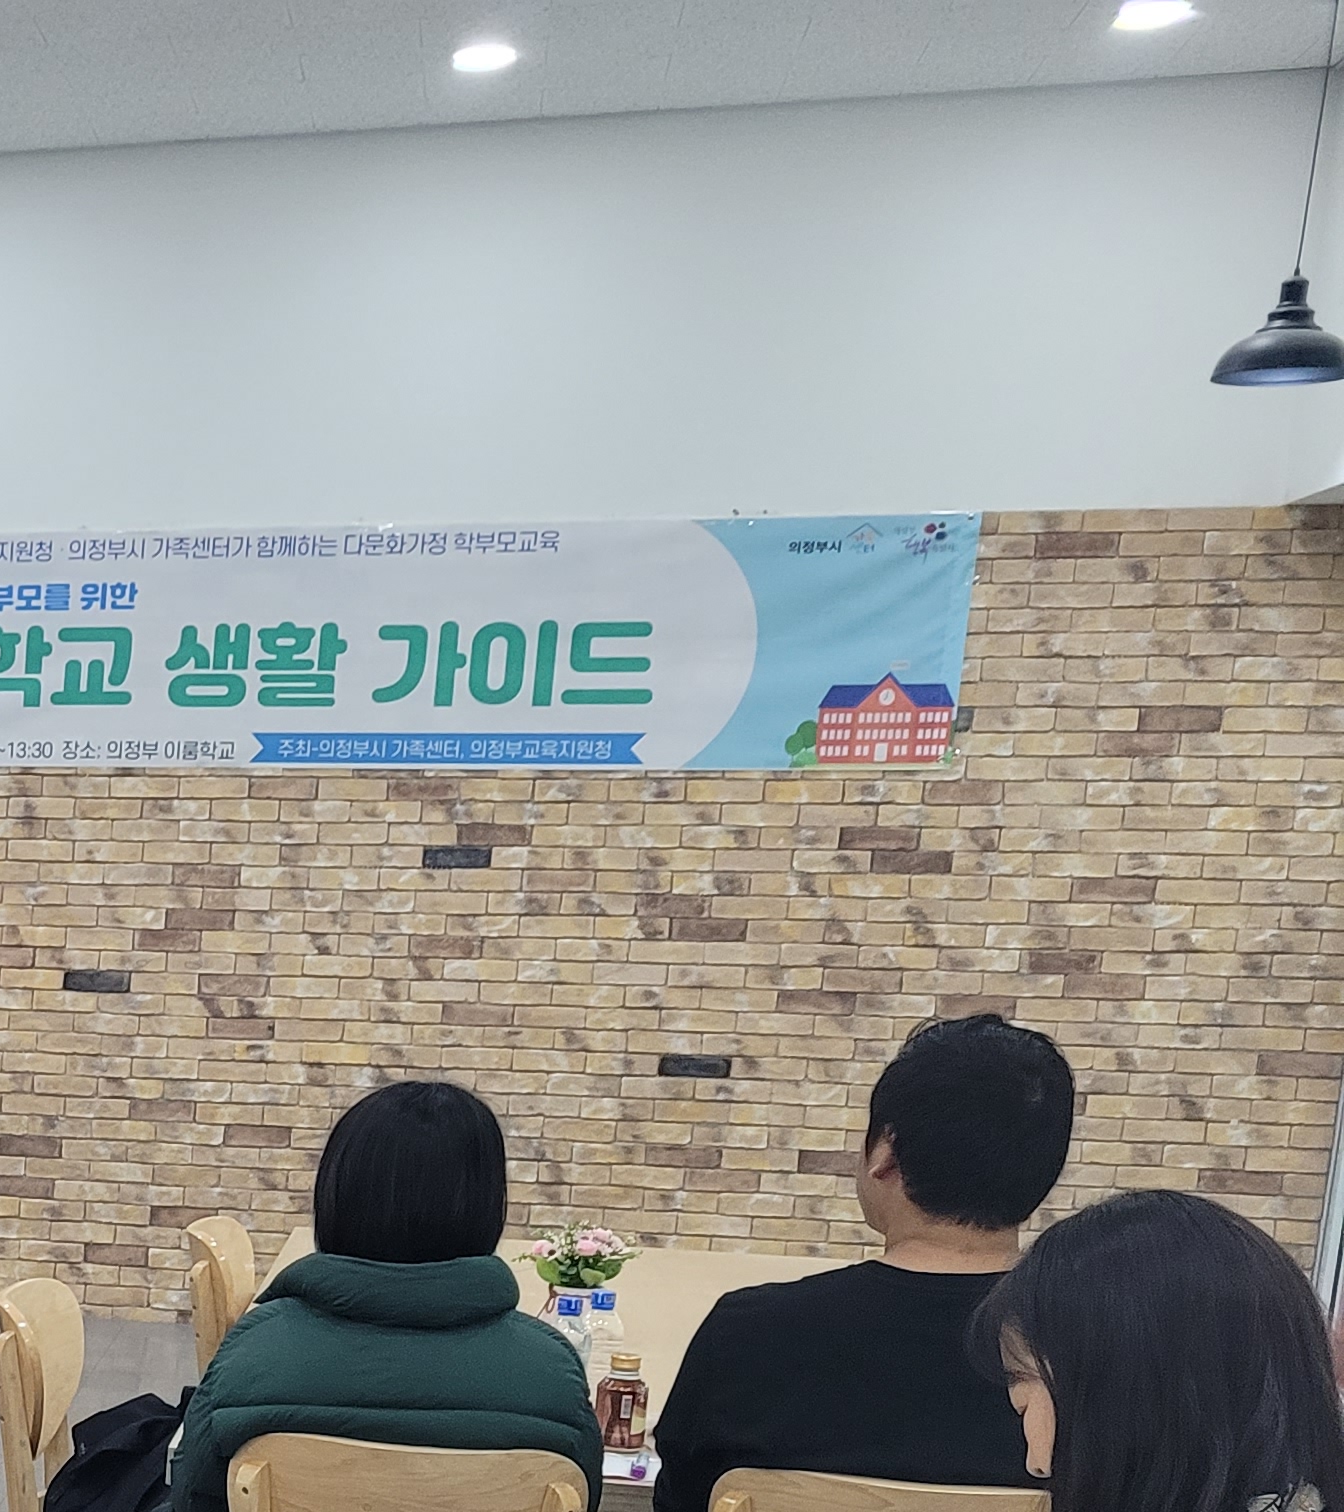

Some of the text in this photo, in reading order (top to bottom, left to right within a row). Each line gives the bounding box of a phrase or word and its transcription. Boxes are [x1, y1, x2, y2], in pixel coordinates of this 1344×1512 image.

[67, 537, 146, 562] 의정부시
[151, 536, 252, 560] 가족센터가
[256, 535, 339, 559] 함께하는
[343, 532, 447, 556] 다문화가정
[454, 531, 561, 555] 학부모교육
[788, 540, 842, 554] 의정부시
[79, 581, 139, 612] 위한
[165, 621, 348, 708] 생활
[371, 620, 654, 707] 가이드
[61, 740, 101, 760] 장소:
[106, 740, 159, 760] 의정부
[164, 740, 236, 761] 이룸학교
[277, 738, 613, 760] 주최-의정부시 가족센터, 의정부교육지원청
